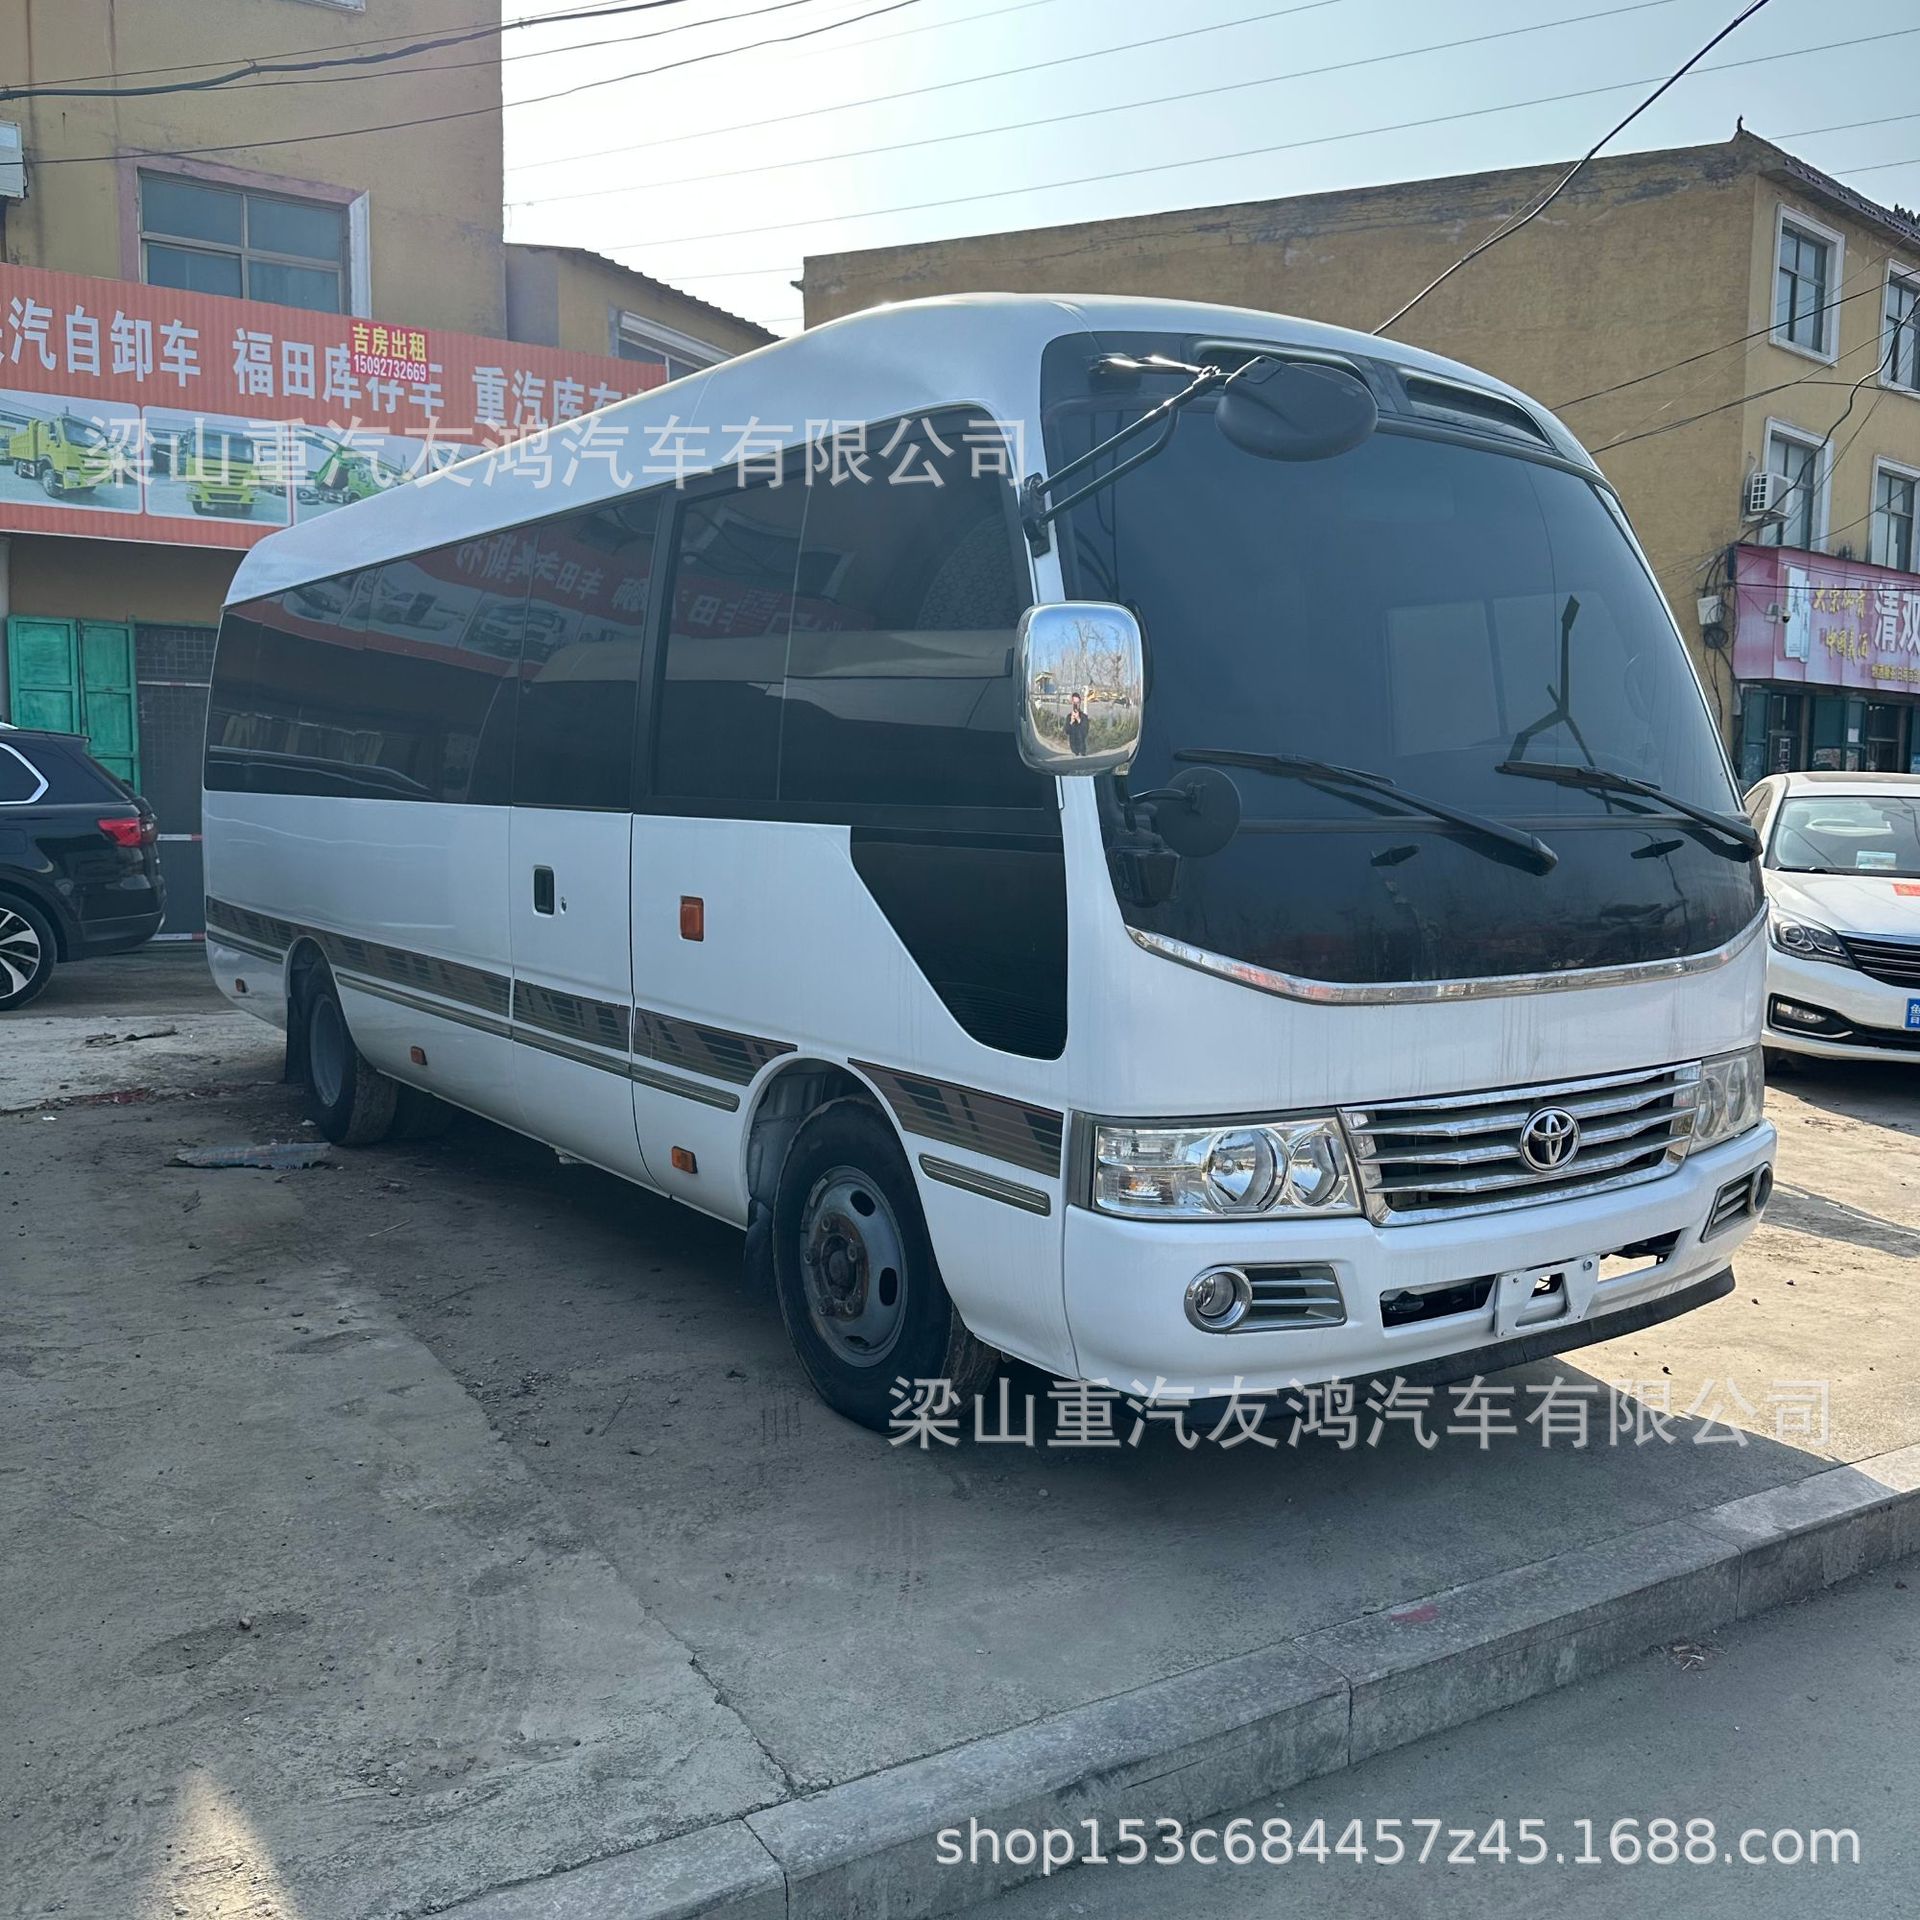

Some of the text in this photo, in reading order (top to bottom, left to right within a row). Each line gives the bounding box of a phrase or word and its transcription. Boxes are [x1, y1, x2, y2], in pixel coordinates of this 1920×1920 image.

[0, 297, 201, 387] 汽自卸车
[352, 323, 427, 362] 吉房出租
[353, 354, 427, 382] 15092732669
